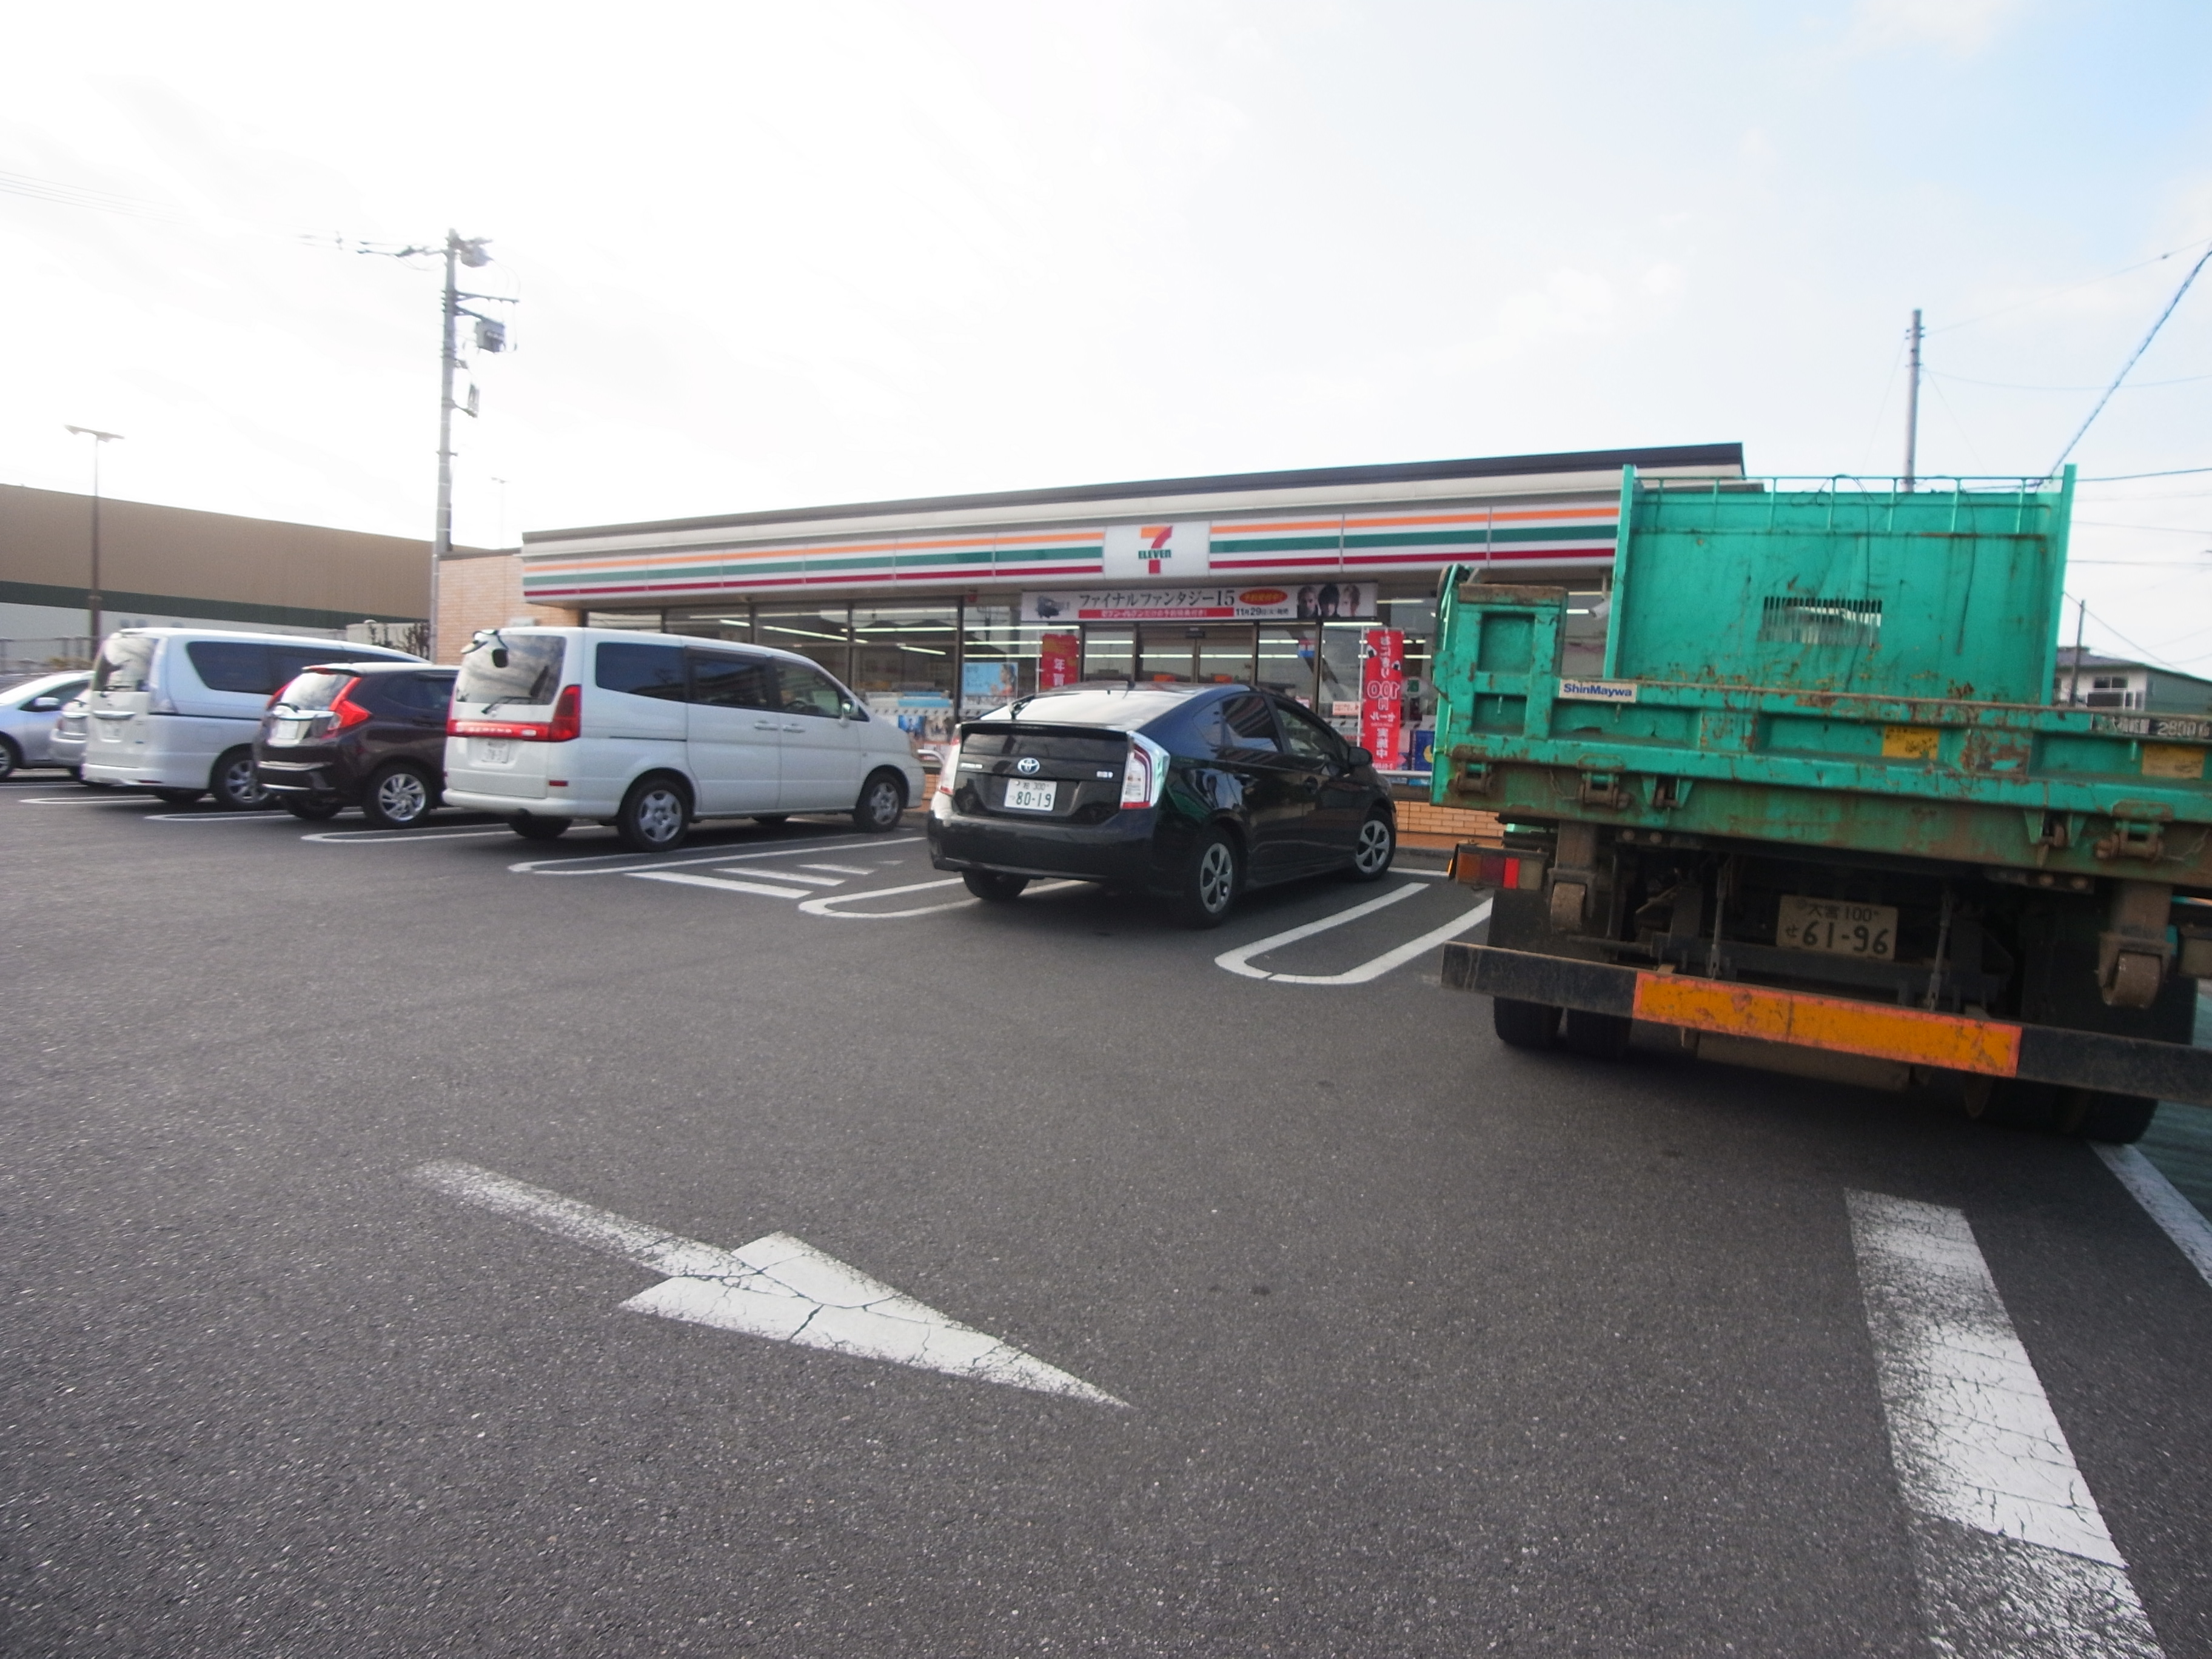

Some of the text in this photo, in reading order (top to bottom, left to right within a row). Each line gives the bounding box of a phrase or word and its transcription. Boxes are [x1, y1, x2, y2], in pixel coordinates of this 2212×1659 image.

[1079, 590, 1235, 608] ファイナルファンタジー15
[1564, 683, 1632, 697] ShinMaywa
[1016, 791, 1051, 808] 80-19
[1803, 921, 1889, 954] 61-96
